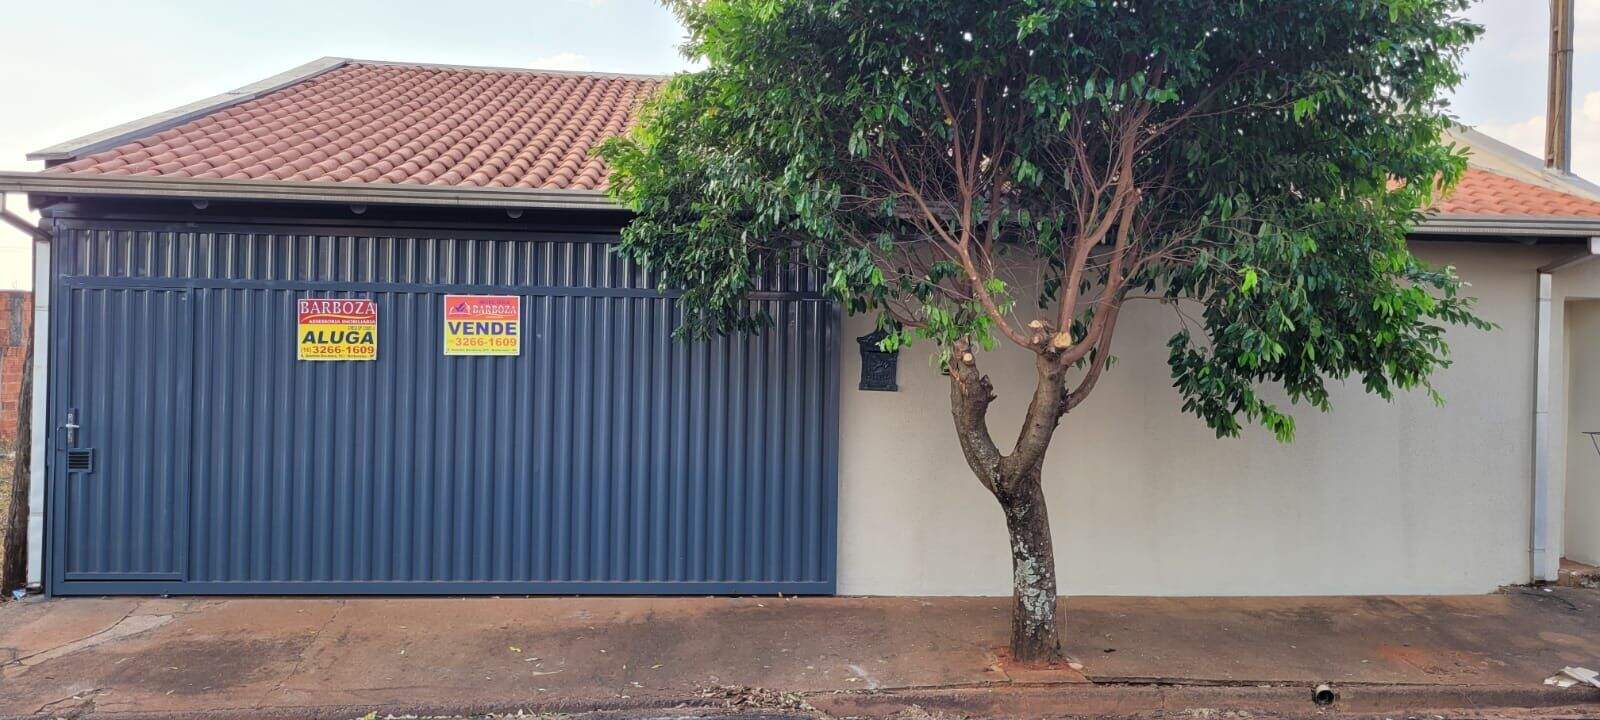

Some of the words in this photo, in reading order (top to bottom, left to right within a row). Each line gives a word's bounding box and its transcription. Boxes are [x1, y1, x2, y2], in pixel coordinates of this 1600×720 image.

[301, 301, 376, 314] BARBOZA
[472, 304, 517, 315] BARBOZA
[447, 321, 517, 336] VENDE
[302, 330, 374, 345] ALUGA
[455, 337, 517, 346] 3266-1609
[312, 345, 375, 354] 3266-1609
